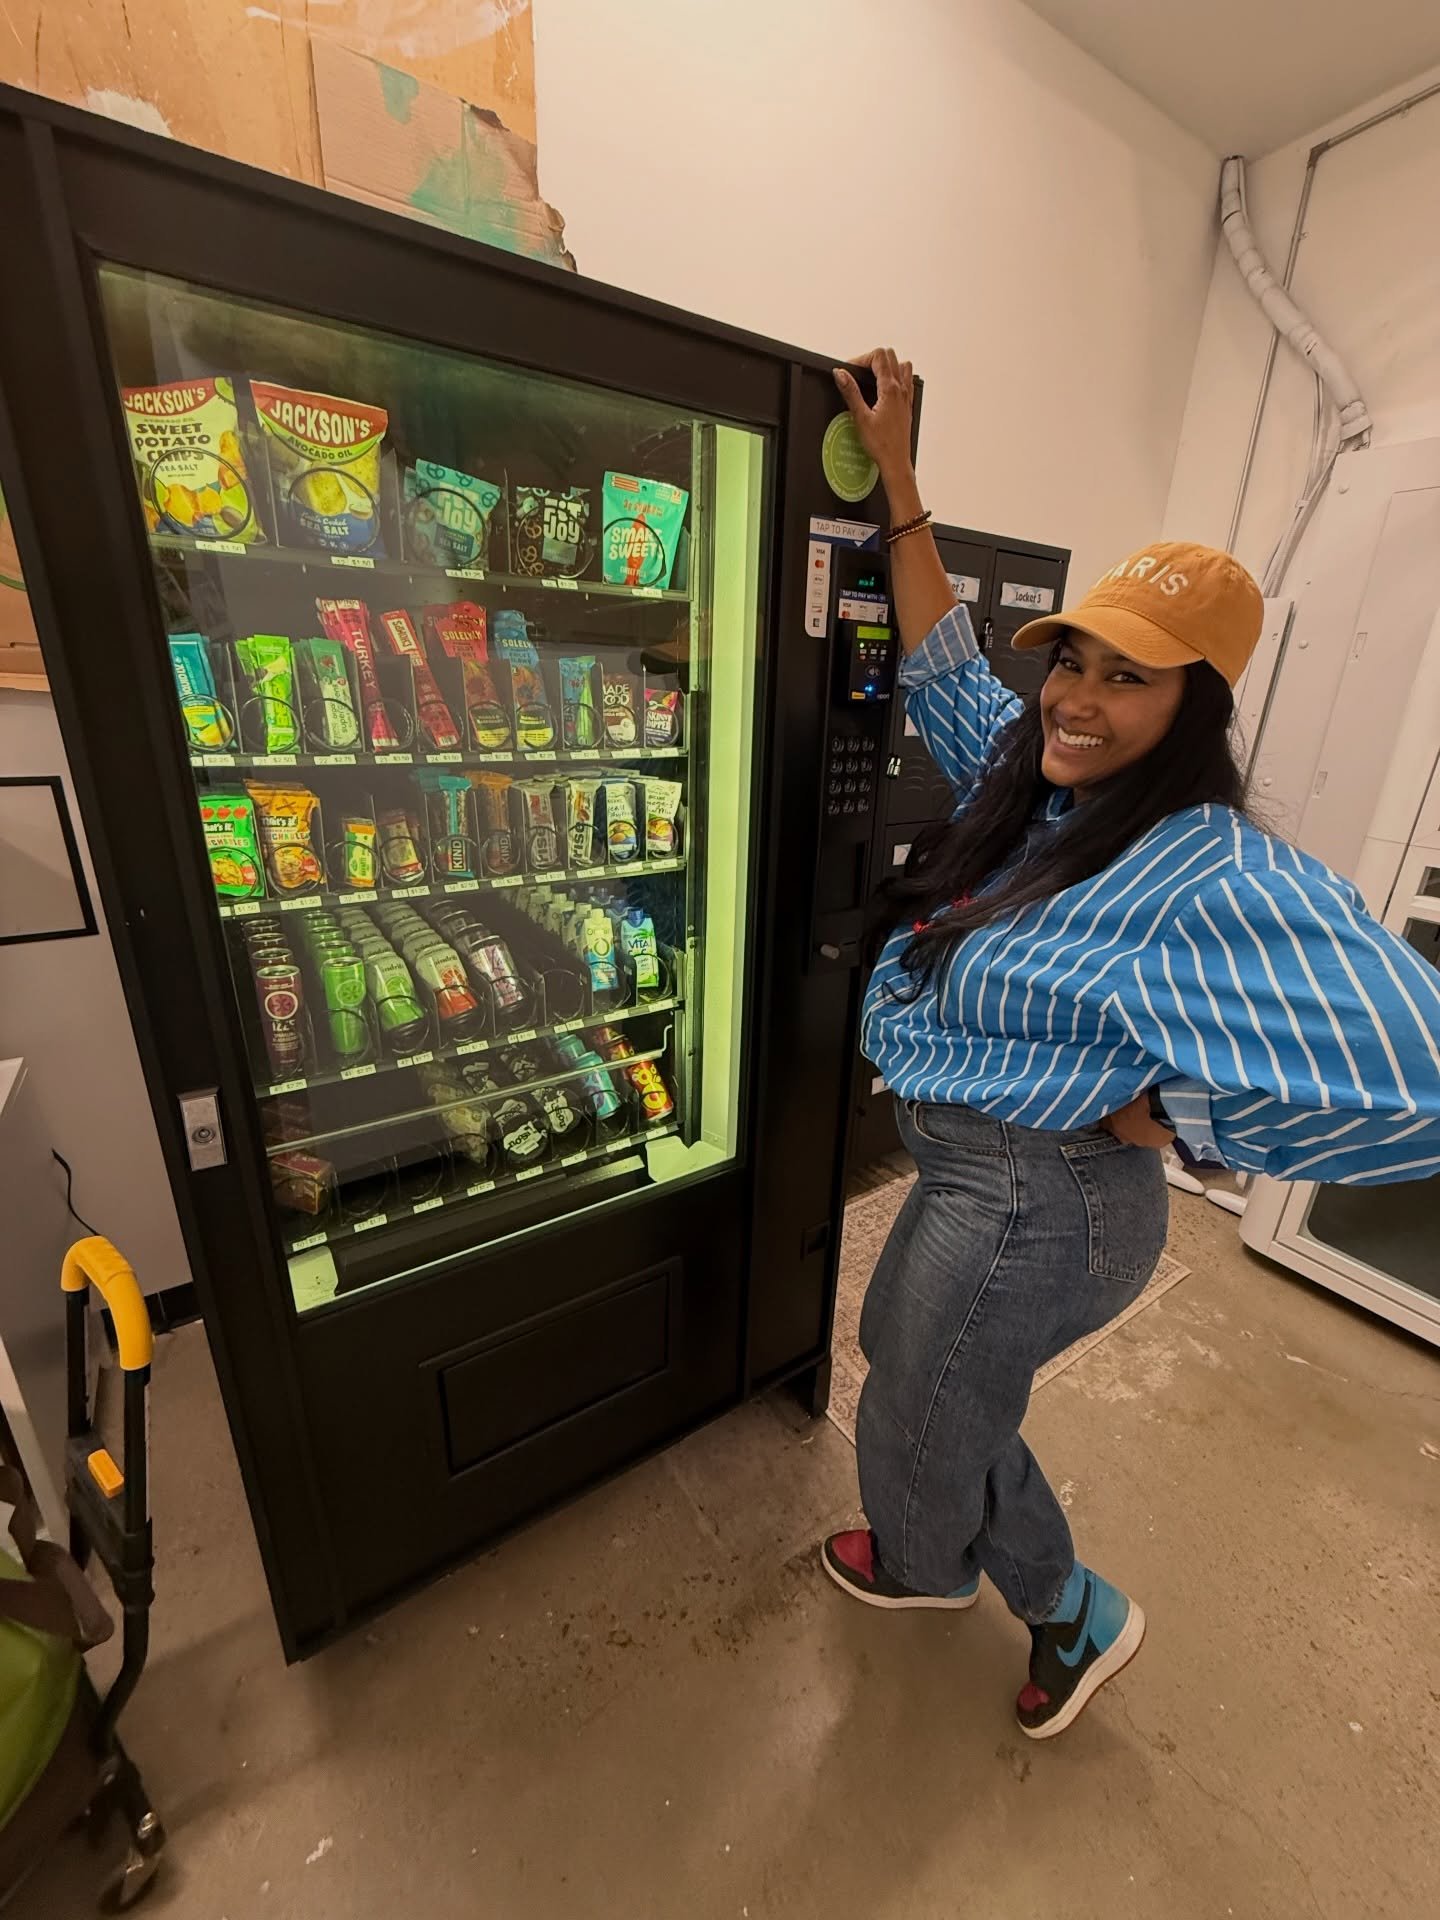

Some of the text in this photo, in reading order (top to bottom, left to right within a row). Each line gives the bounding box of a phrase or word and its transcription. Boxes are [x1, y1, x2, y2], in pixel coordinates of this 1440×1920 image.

[124, 387, 206, 415] JACKSON'S
[136, 422, 203, 436] SWEET
[270, 400, 371, 444] JACKSON'S
[134, 434, 212, 450] POTATO
[288, 436, 353, 460] AVOCADO OIL
[147, 449, 205, 464] CHIPS
[159, 463, 199, 473] SEA SALT
[324, 525, 350, 536] SALT
[611, 527, 663, 543] SMART
[816, 521, 856, 537] TAP TO PAY
[452, 540, 468, 553] SALT
[816, 547, 826, 555] VISA
[858, 591, 867, 599] PAY
[960, 582, 966, 594] 2
[1015, 591, 1042, 604] Locker 3
[502, 638, 534, 650] SOLELY
[351, 628, 377, 689] TURKEY
[603, 694, 630, 706] OOD
[453, 840, 463, 869] KIND
[500, 838, 510, 864] KIND
[628, 938, 648, 950] VITA
